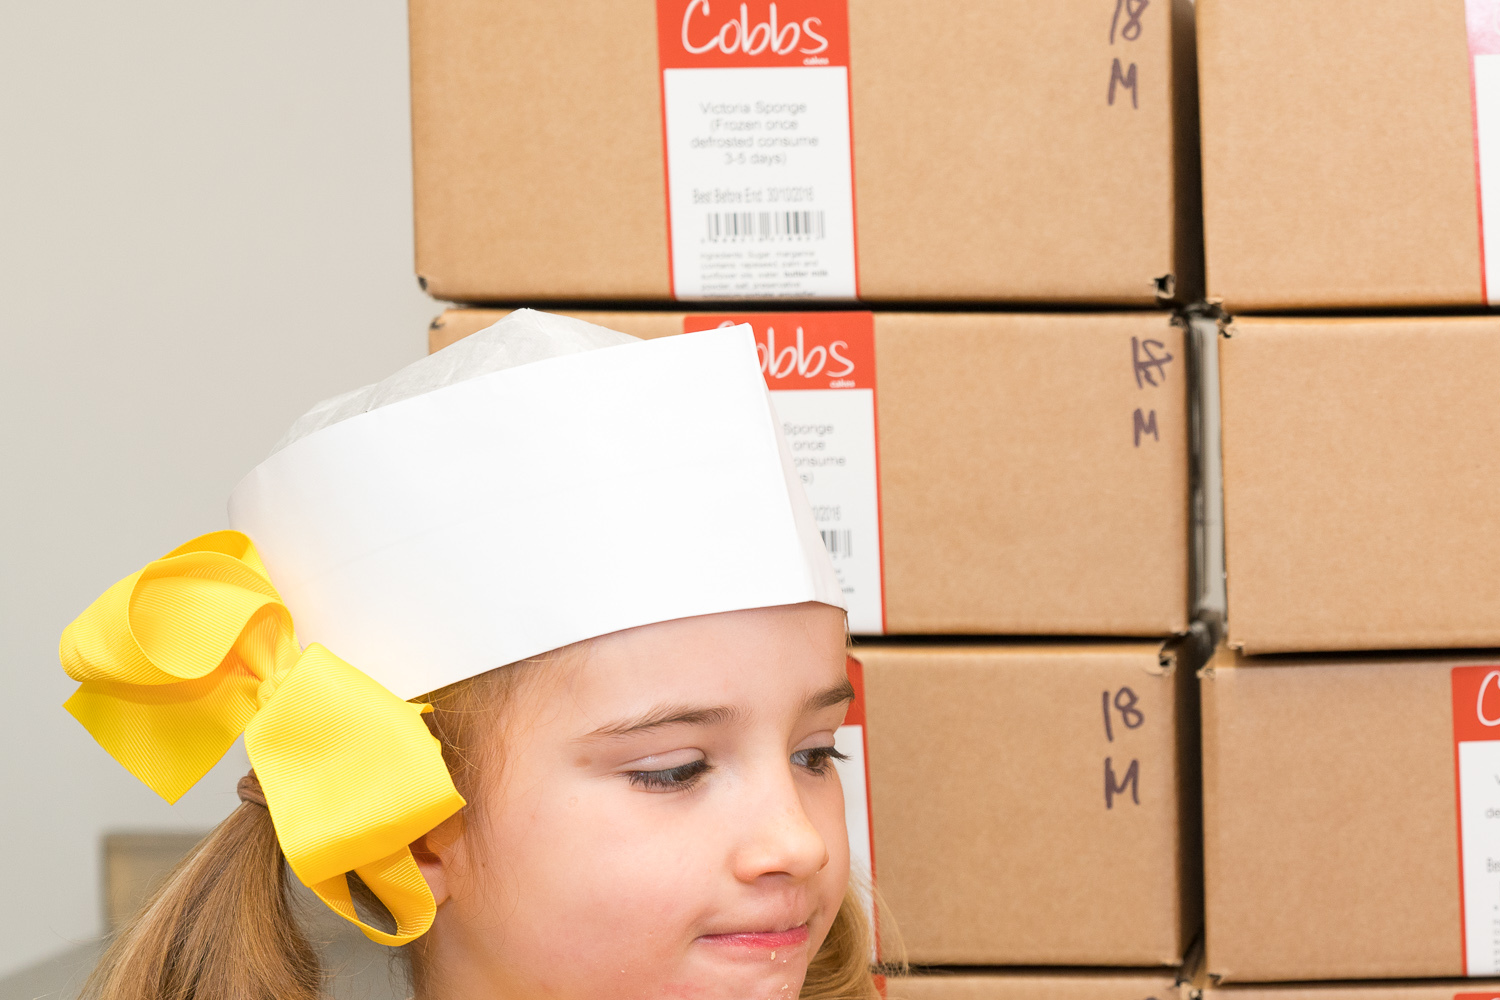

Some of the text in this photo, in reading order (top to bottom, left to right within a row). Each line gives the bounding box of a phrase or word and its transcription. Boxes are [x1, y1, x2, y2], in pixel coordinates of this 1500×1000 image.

[682, 0, 828, 55] Cobbs
[1109, 0, 1148, 45] 18
[803, 56, 829, 65] cakes
[1107, 57, 1137, 109] M
[700, 101, 807, 116] Victoria Sponge
[711, 119, 798, 132] (Frozen once
[690, 135, 819, 148] defrosted consume
[725, 152, 787, 166] 3-5 days)
[756, 326, 855, 379] obbs
[783, 423, 834, 436] Sponge
[1132, 408, 1159, 448] M
[793, 440, 825, 451] once
[793, 456, 846, 467] onsume
[1103, 685, 1145, 742] 18
[1104, 757, 1140, 809] M
